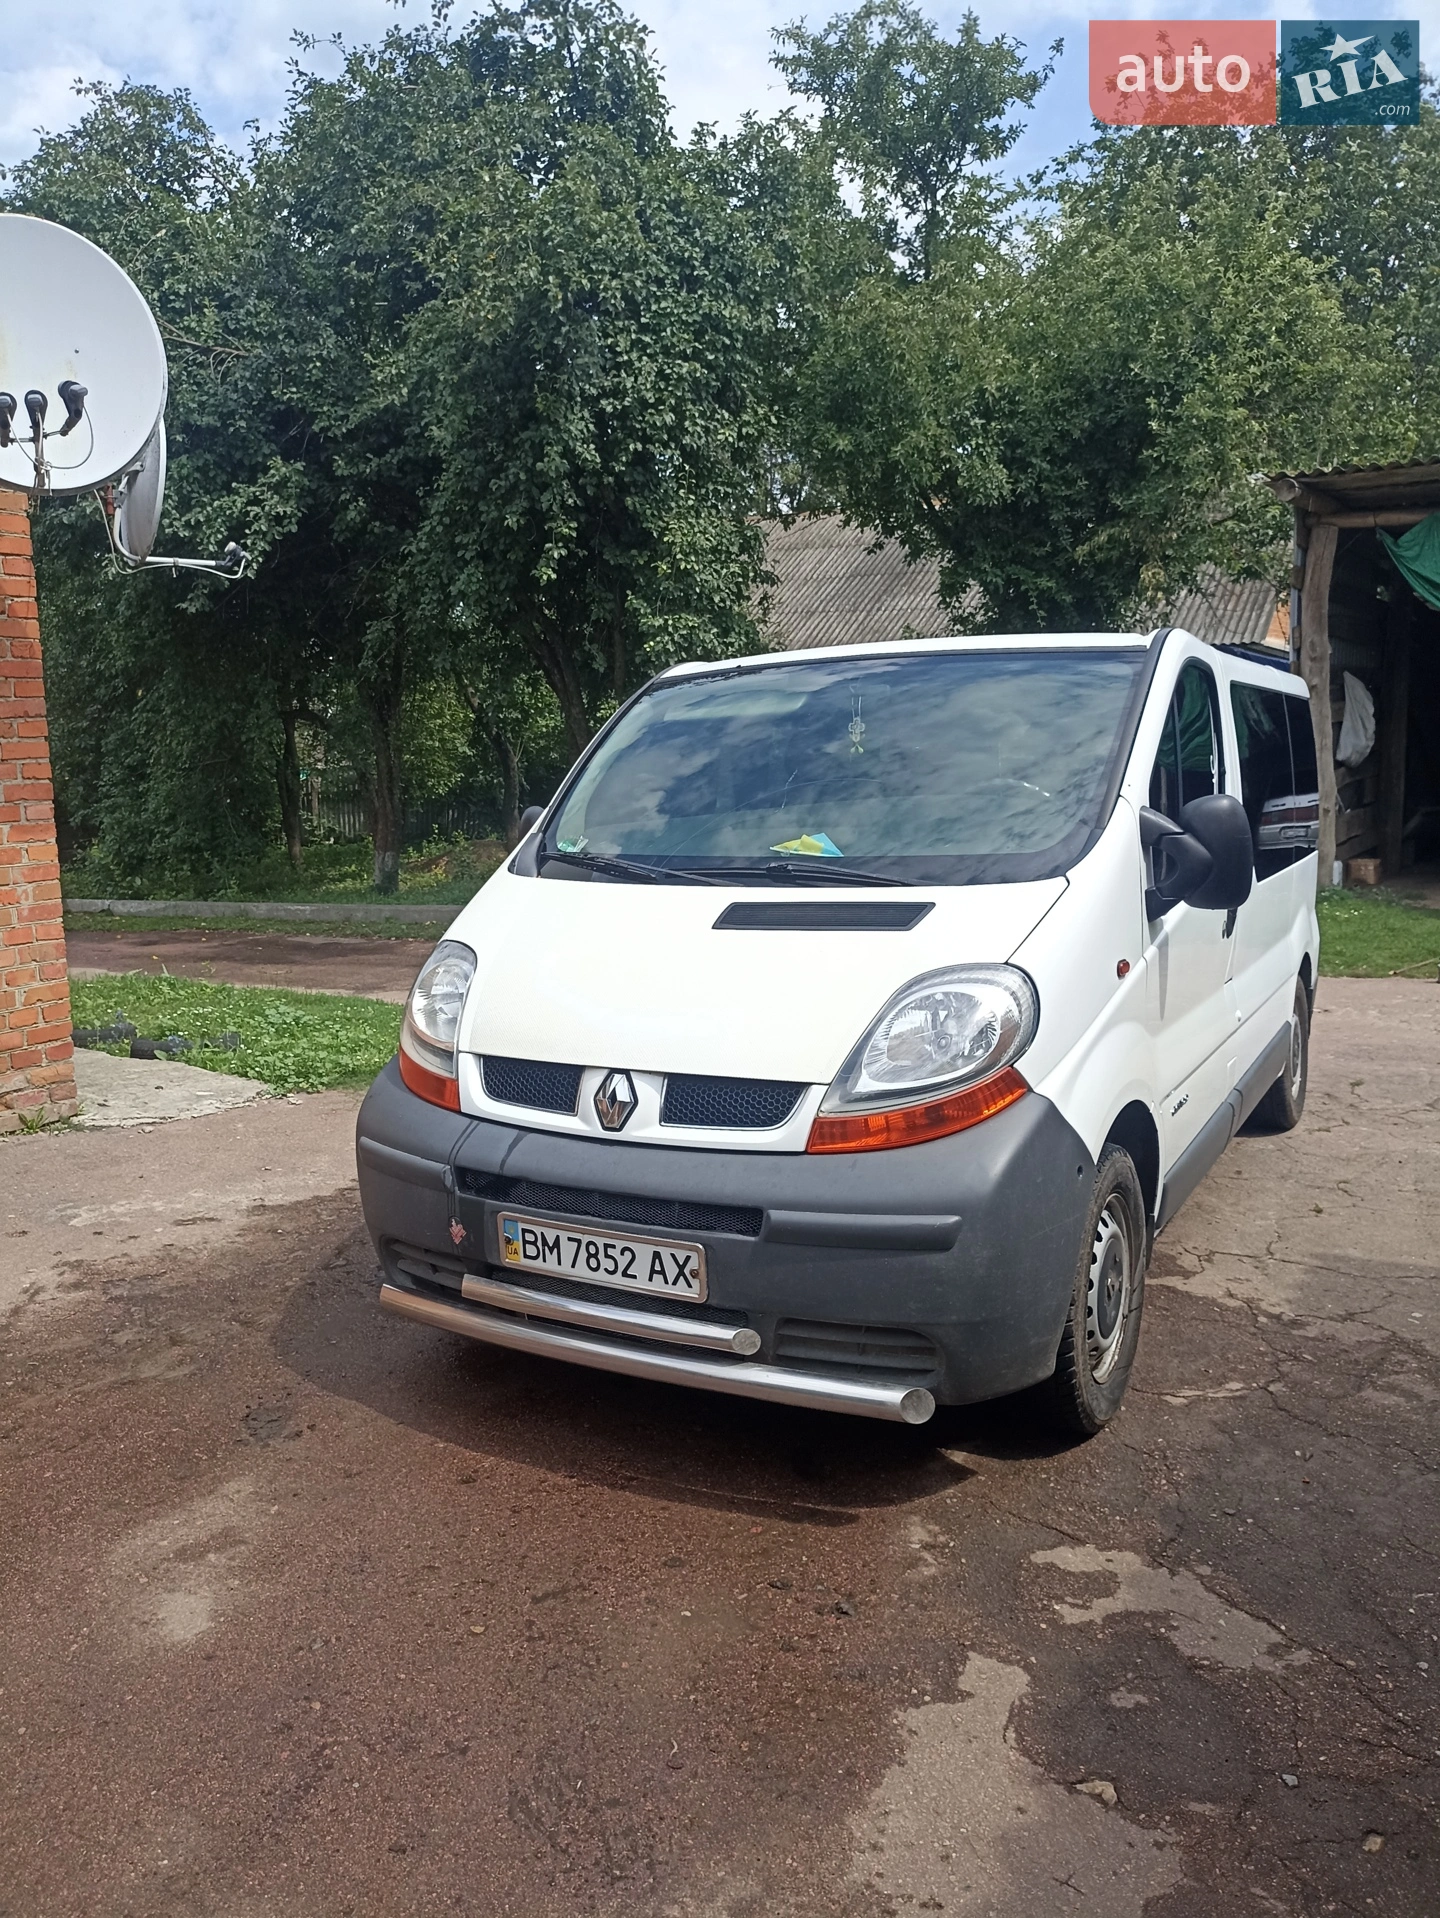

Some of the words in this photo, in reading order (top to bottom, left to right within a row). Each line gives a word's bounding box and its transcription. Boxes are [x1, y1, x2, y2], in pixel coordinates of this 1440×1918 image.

[507, 1245, 519, 1257] UA
[521, 1227, 562, 1266] BM
[567, 1236, 638, 1280] 7852
[648, 1250, 693, 1289] AX
